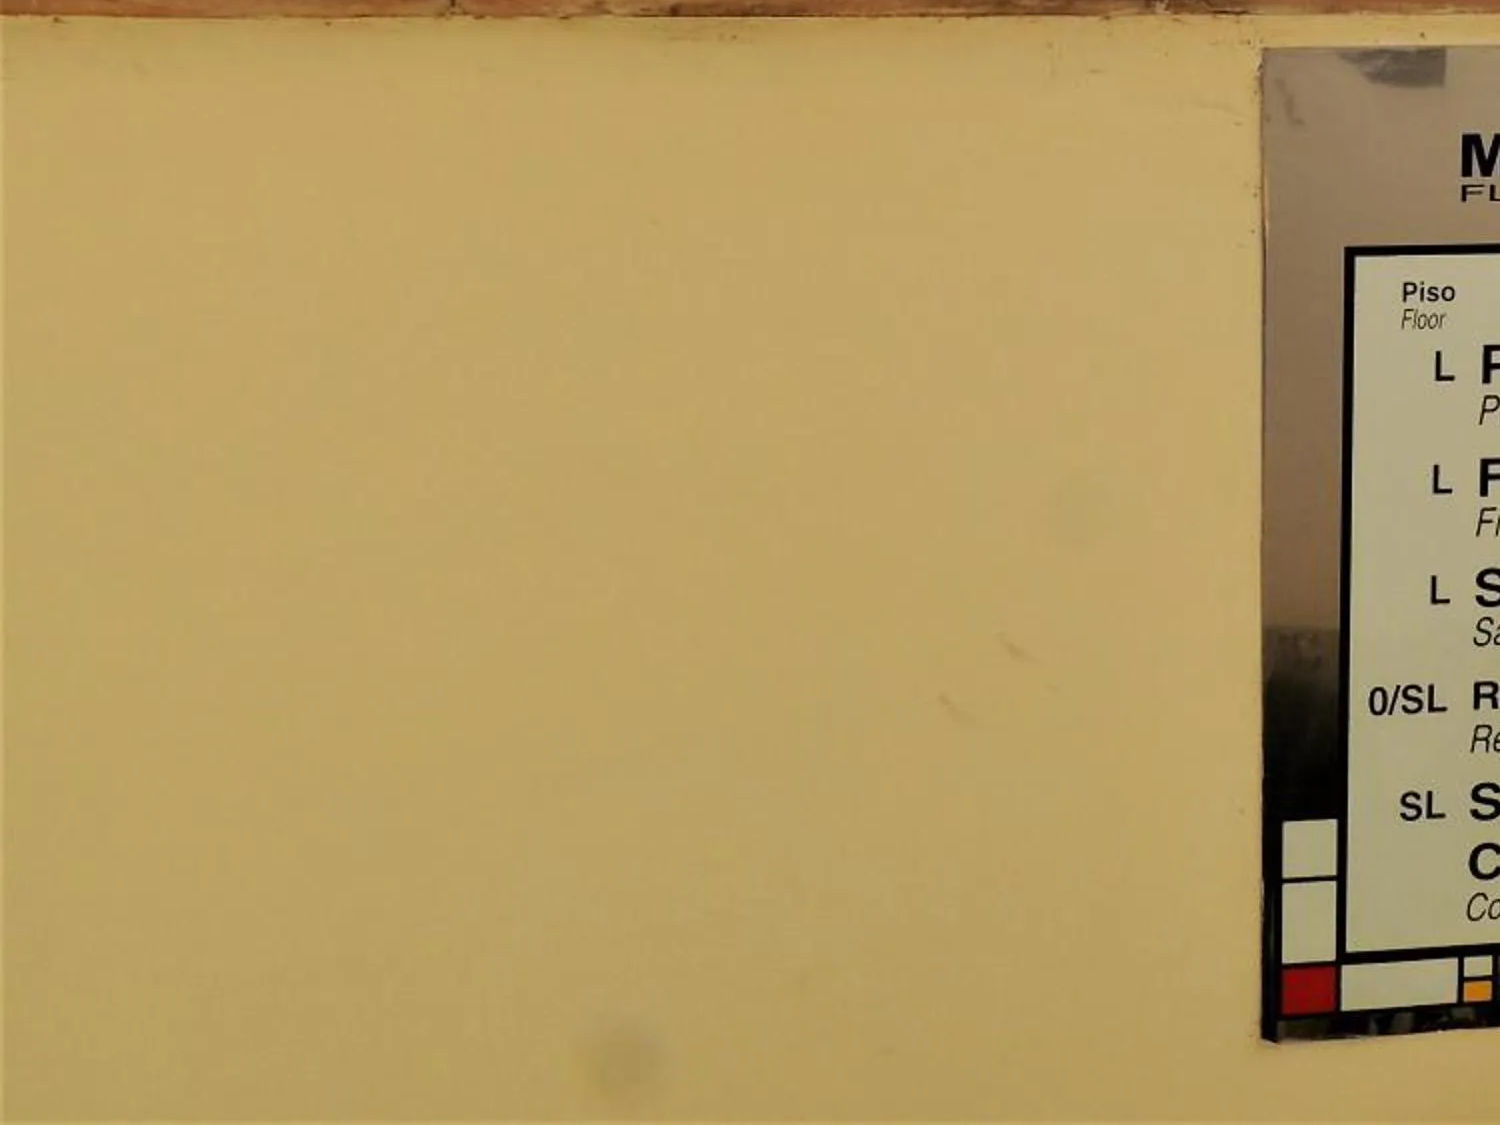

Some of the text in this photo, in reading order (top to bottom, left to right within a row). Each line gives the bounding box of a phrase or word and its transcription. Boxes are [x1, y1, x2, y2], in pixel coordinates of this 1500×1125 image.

[1403, 282, 1455, 302] Piso
[1402, 309, 1444, 329] Floor
[1435, 351, 1455, 381] L
[1433, 465, 1452, 494] L
[1431, 575, 1450, 605] L
[1369, 684, 1447, 715] 0/SL
[1400, 791, 1446, 821] SL
